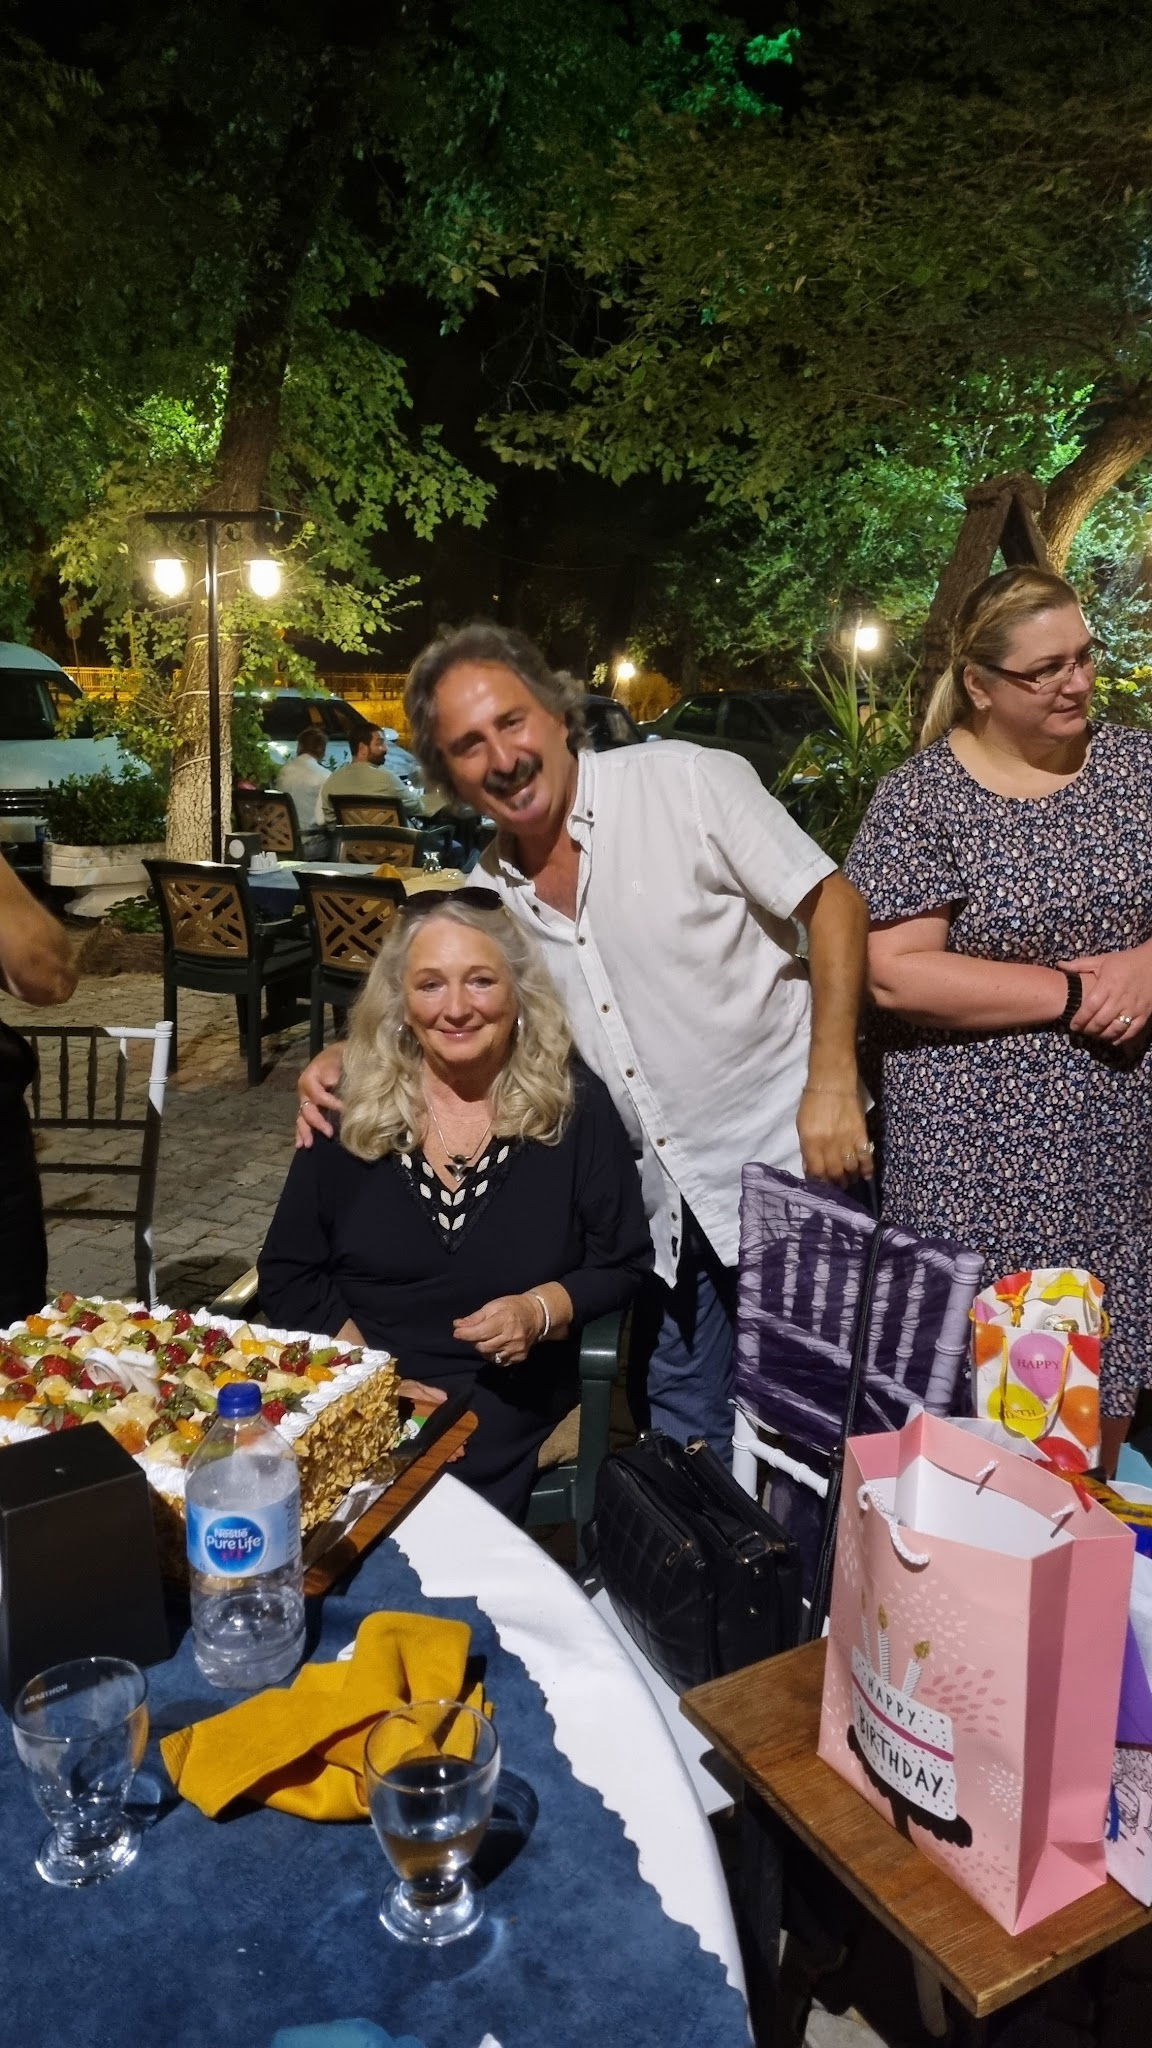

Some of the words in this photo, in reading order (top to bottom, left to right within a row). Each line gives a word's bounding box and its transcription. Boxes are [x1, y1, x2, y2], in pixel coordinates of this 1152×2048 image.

[1016, 1359, 1060, 1369] HAPPY
[997, 1408, 1037, 1419] IRTH
[206, 1535, 236, 1550] Pure
[238, 1535, 262, 1553] Life
[867, 1678, 917, 1726] HAPPY
[858, 1704, 944, 1799] BIRTHDAY
